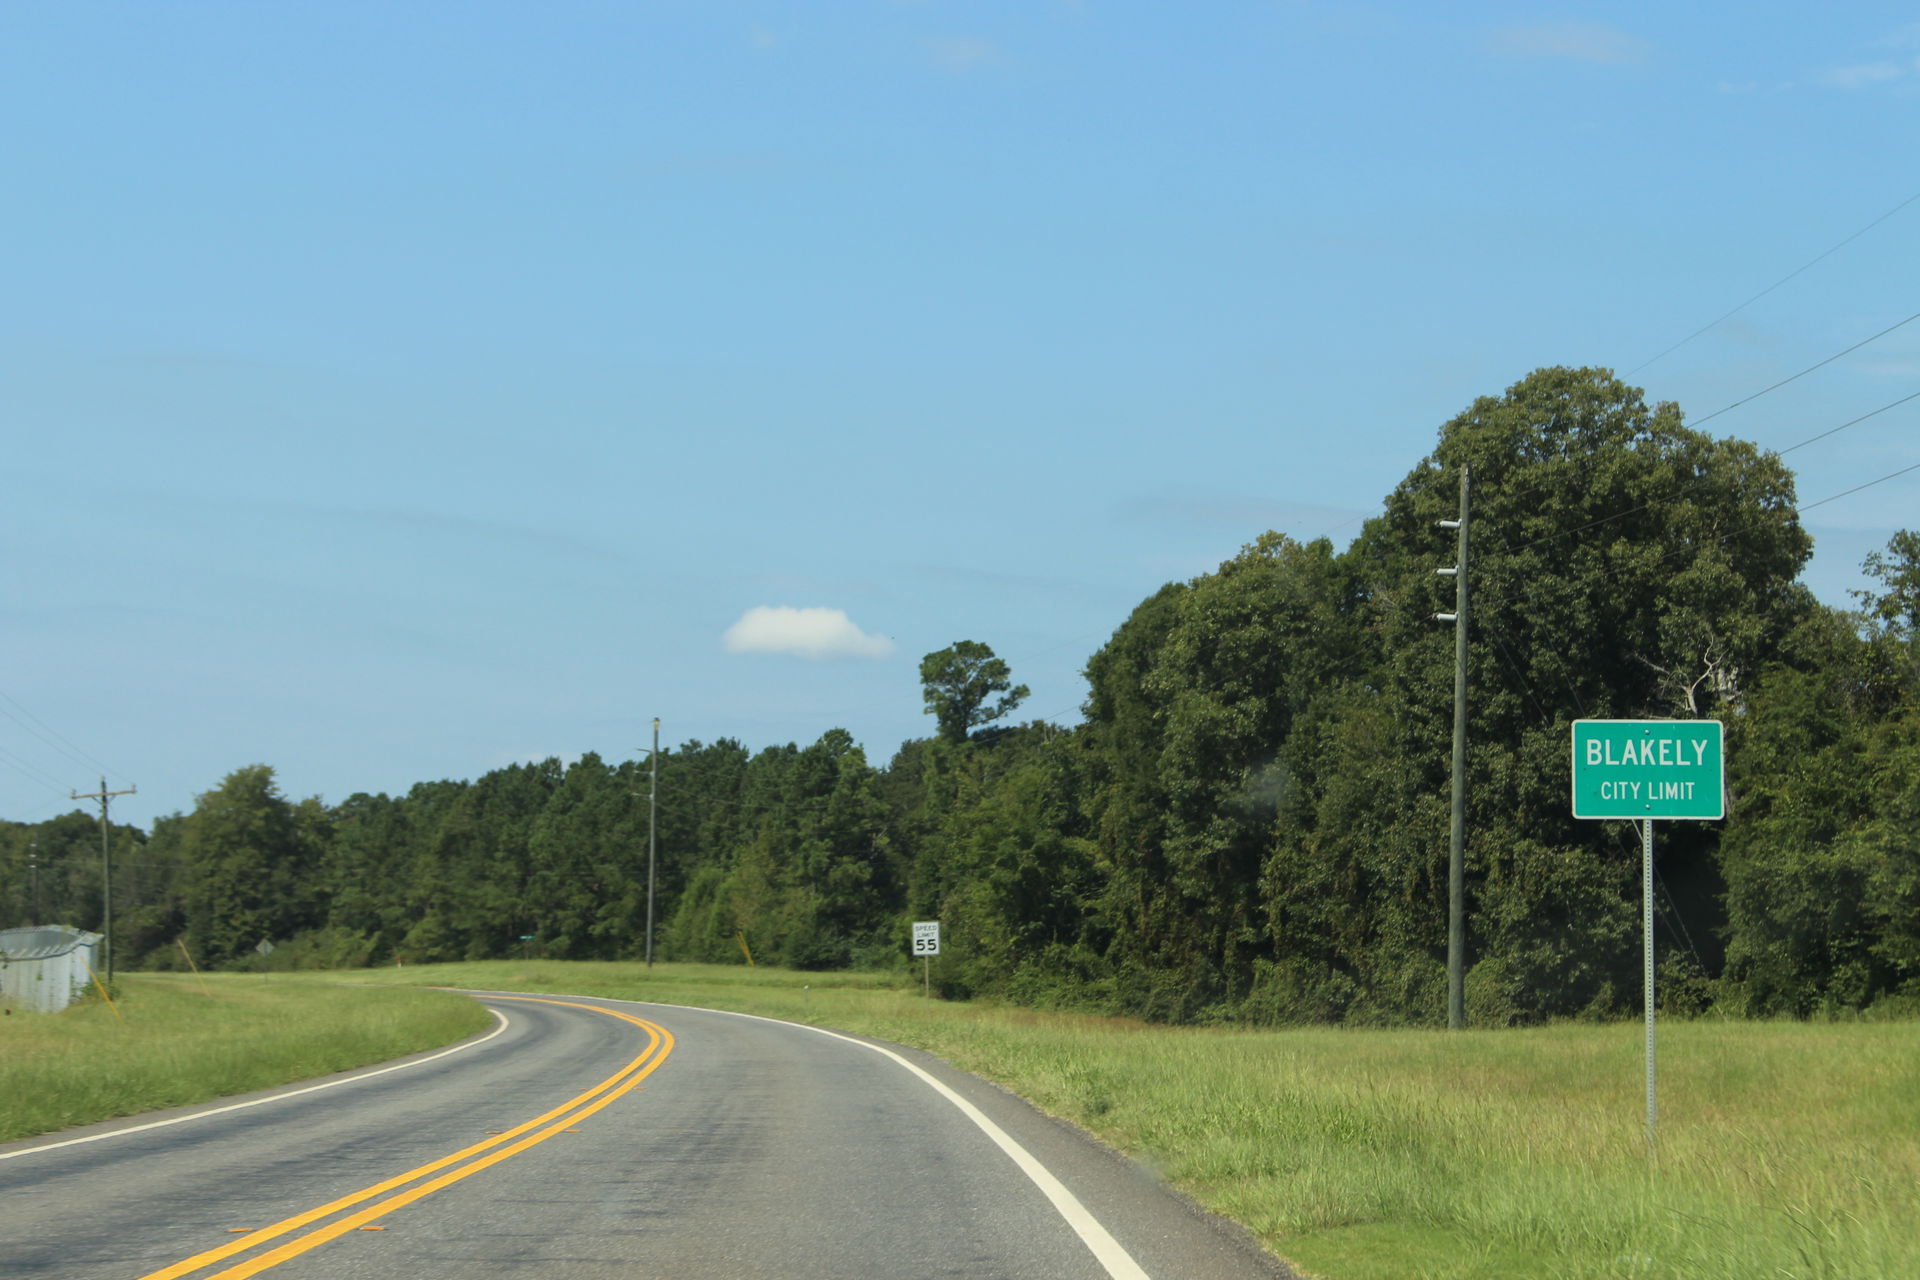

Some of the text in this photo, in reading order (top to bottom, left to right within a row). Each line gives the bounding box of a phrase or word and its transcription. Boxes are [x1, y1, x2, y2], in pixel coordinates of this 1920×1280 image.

[1586, 739, 1708, 766] BLAKELY
[1601, 781, 1695, 800] CITY LIMIT
[916, 939, 937, 951] 55
